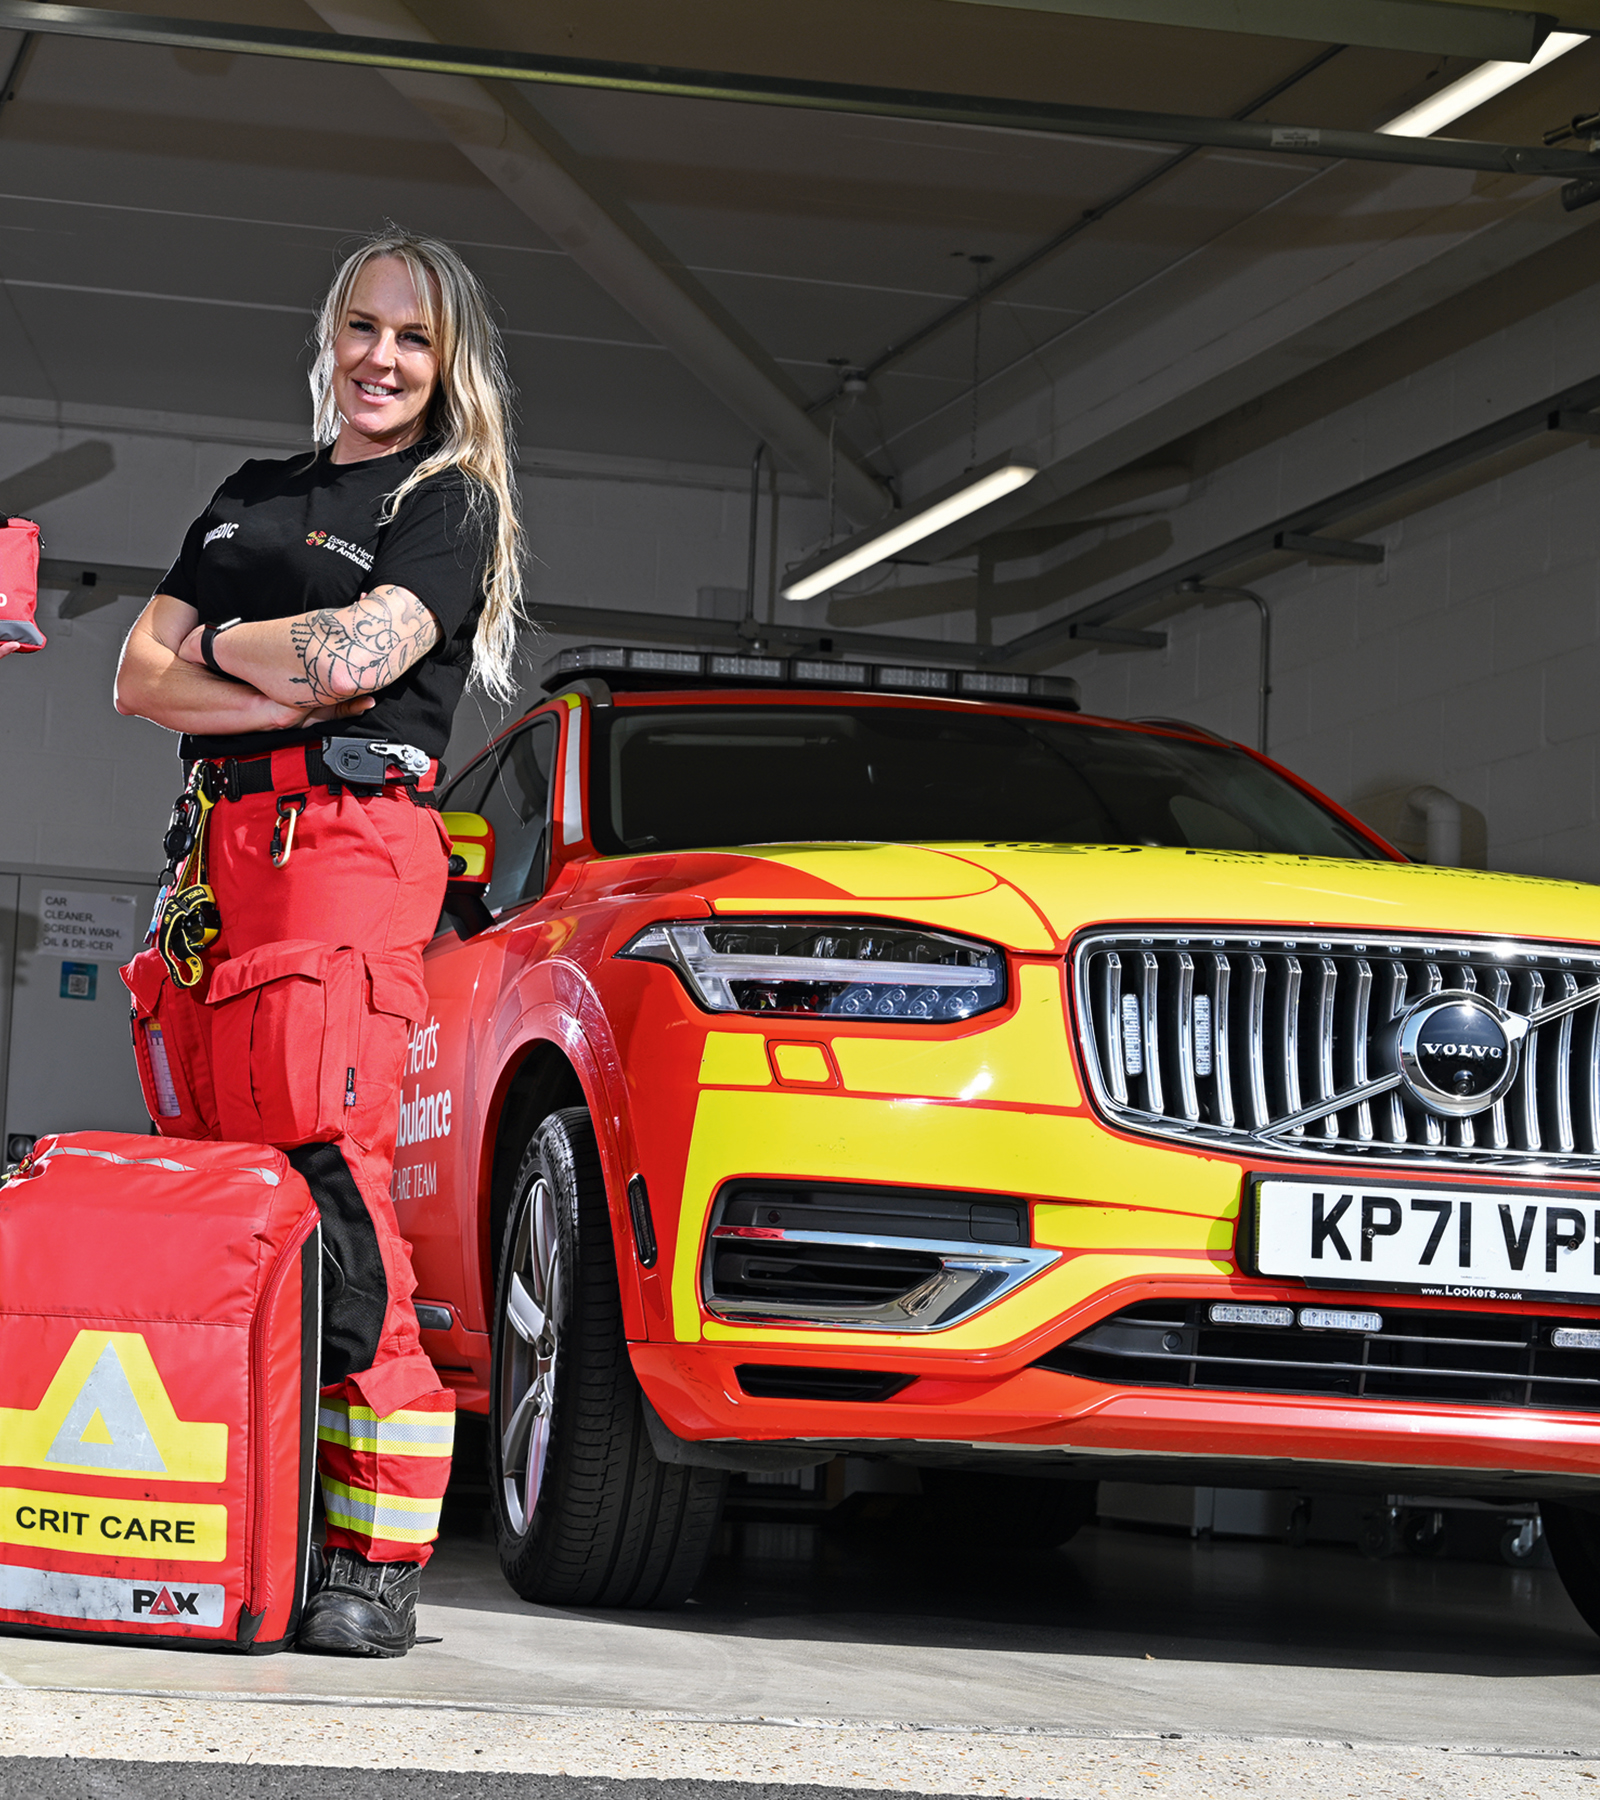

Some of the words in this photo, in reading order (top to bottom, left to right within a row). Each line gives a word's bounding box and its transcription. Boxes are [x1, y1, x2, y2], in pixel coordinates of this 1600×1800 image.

[323, 542, 338, 551] Air
[336, 546, 373, 572] Ambulan
[328, 535, 349, 548] Essex
[348, 543, 357, 552] &
[356, 547, 375, 564] Hert
[45, 896, 67, 906] CAR
[43, 923, 86, 935] SCREEN
[88, 926, 122, 939] WASH,
[44, 909, 95, 924] CLEANER,
[43, 936, 59, 947] OIL
[62, 938, 69, 948] &
[71, 940, 113, 951] DE-ICER
[1422, 1043, 1503, 1059] VOLVO
[396, 1084, 452, 1148] bulance
[391, 1166, 411, 1202] CARE
[414, 1161, 437, 1198] TEAM
[1311, 1192, 1472, 1268] KP71
[1497, 1203, 1600, 1276] VP
[1421, 1284, 1522, 1300] www.Lookers.co.uk
[16, 1506, 89, 1535] CRIT
[100, 1516, 195, 1544] CARE
[133, 1586, 199, 1615] PAX
